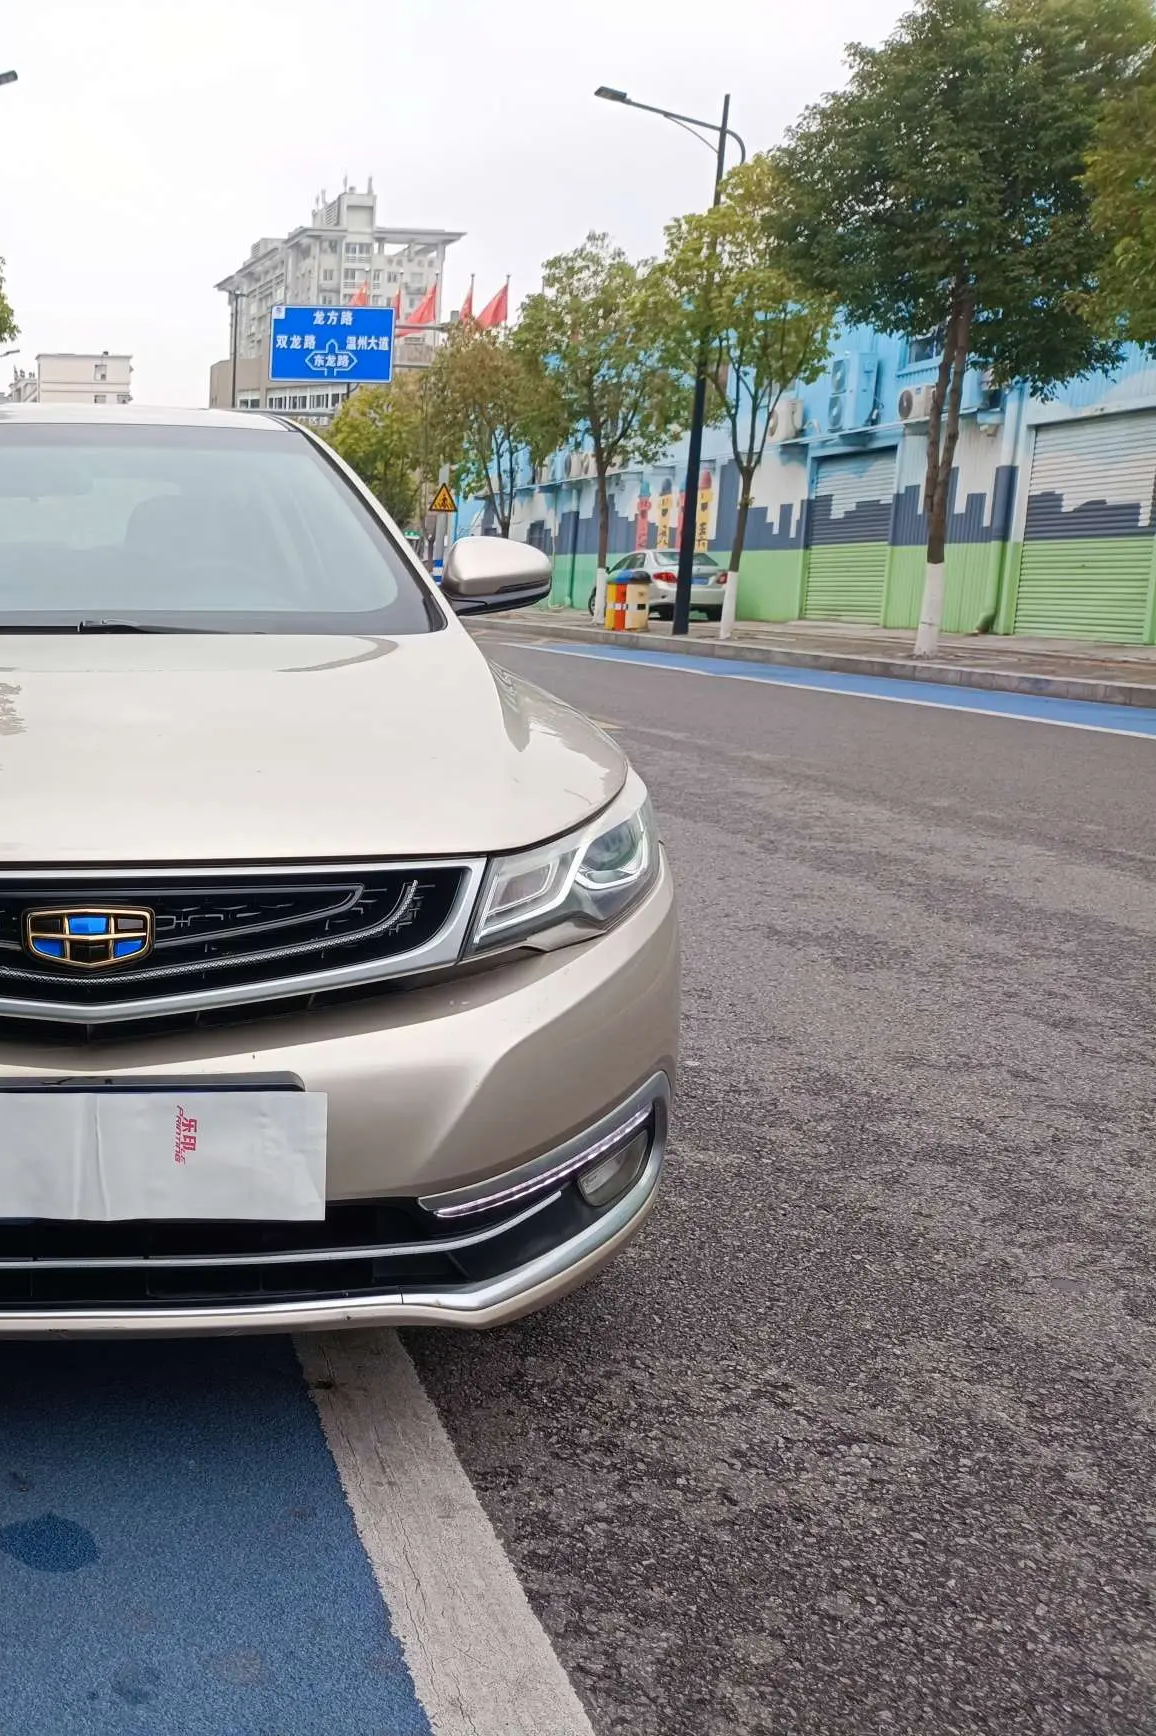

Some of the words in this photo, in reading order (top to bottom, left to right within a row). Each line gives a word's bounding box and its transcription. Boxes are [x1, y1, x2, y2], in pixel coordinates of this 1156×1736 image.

[313, 310, 353, 326] 龙方路
[276, 334, 316, 350] 双龙路
[346, 335, 389, 351] 温州大道
[313, 355, 350, 367] 东龙路
[181, 1117, 197, 1151] 乐印
